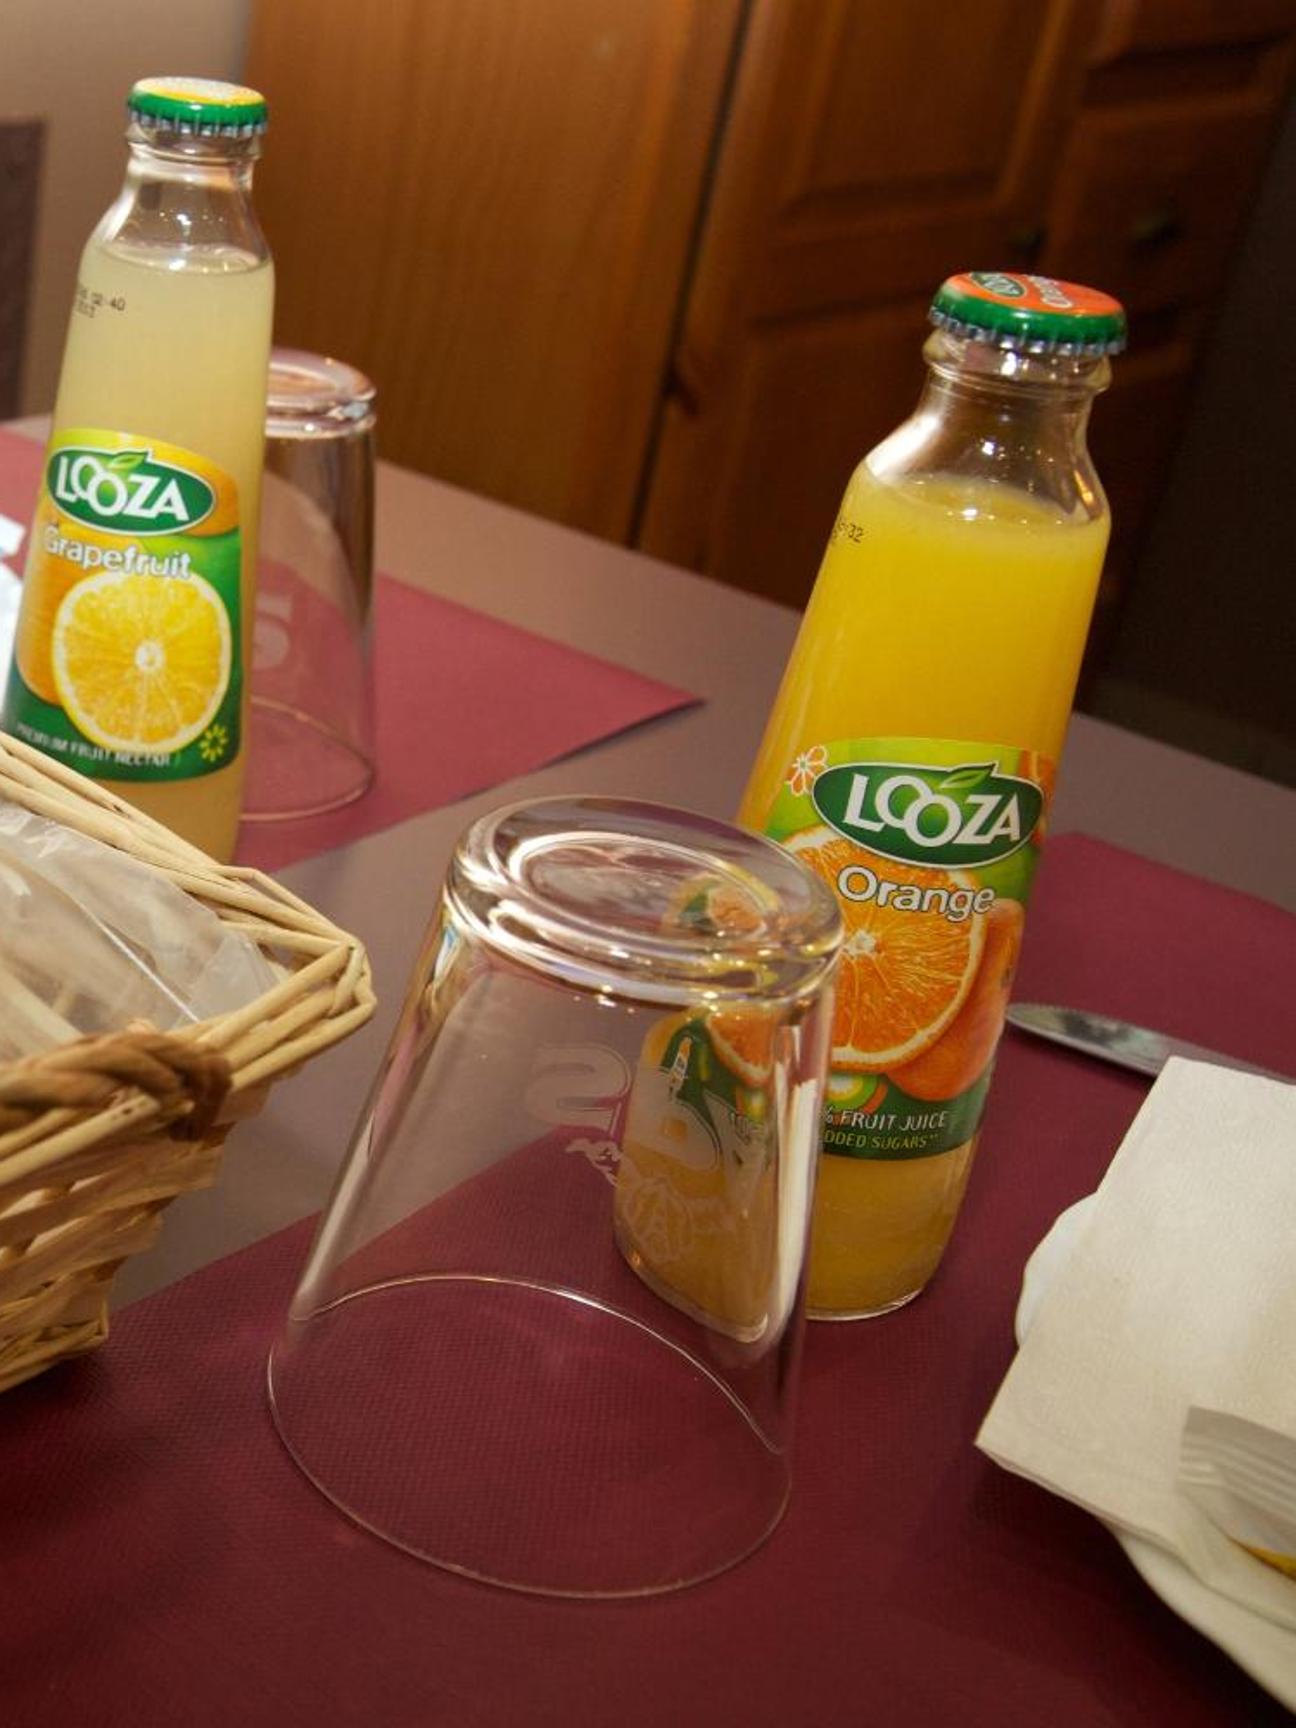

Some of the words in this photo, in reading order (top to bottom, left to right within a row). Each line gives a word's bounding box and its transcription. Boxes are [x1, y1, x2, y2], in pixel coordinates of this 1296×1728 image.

[56, 455, 189, 521] LOOZA
[45, 524, 191, 578] Grapefruit
[70, 741, 111, 761] FRUIT
[115, 753, 171, 767] NECTAR
[842, 774, 1021, 847] LOOZA
[838, 865, 995, 922] Orange
[823, 1130, 866, 1148] DDED
[841, 1110, 895, 1130] FRUIT
[899, 1110, 950, 1131] JUICE
